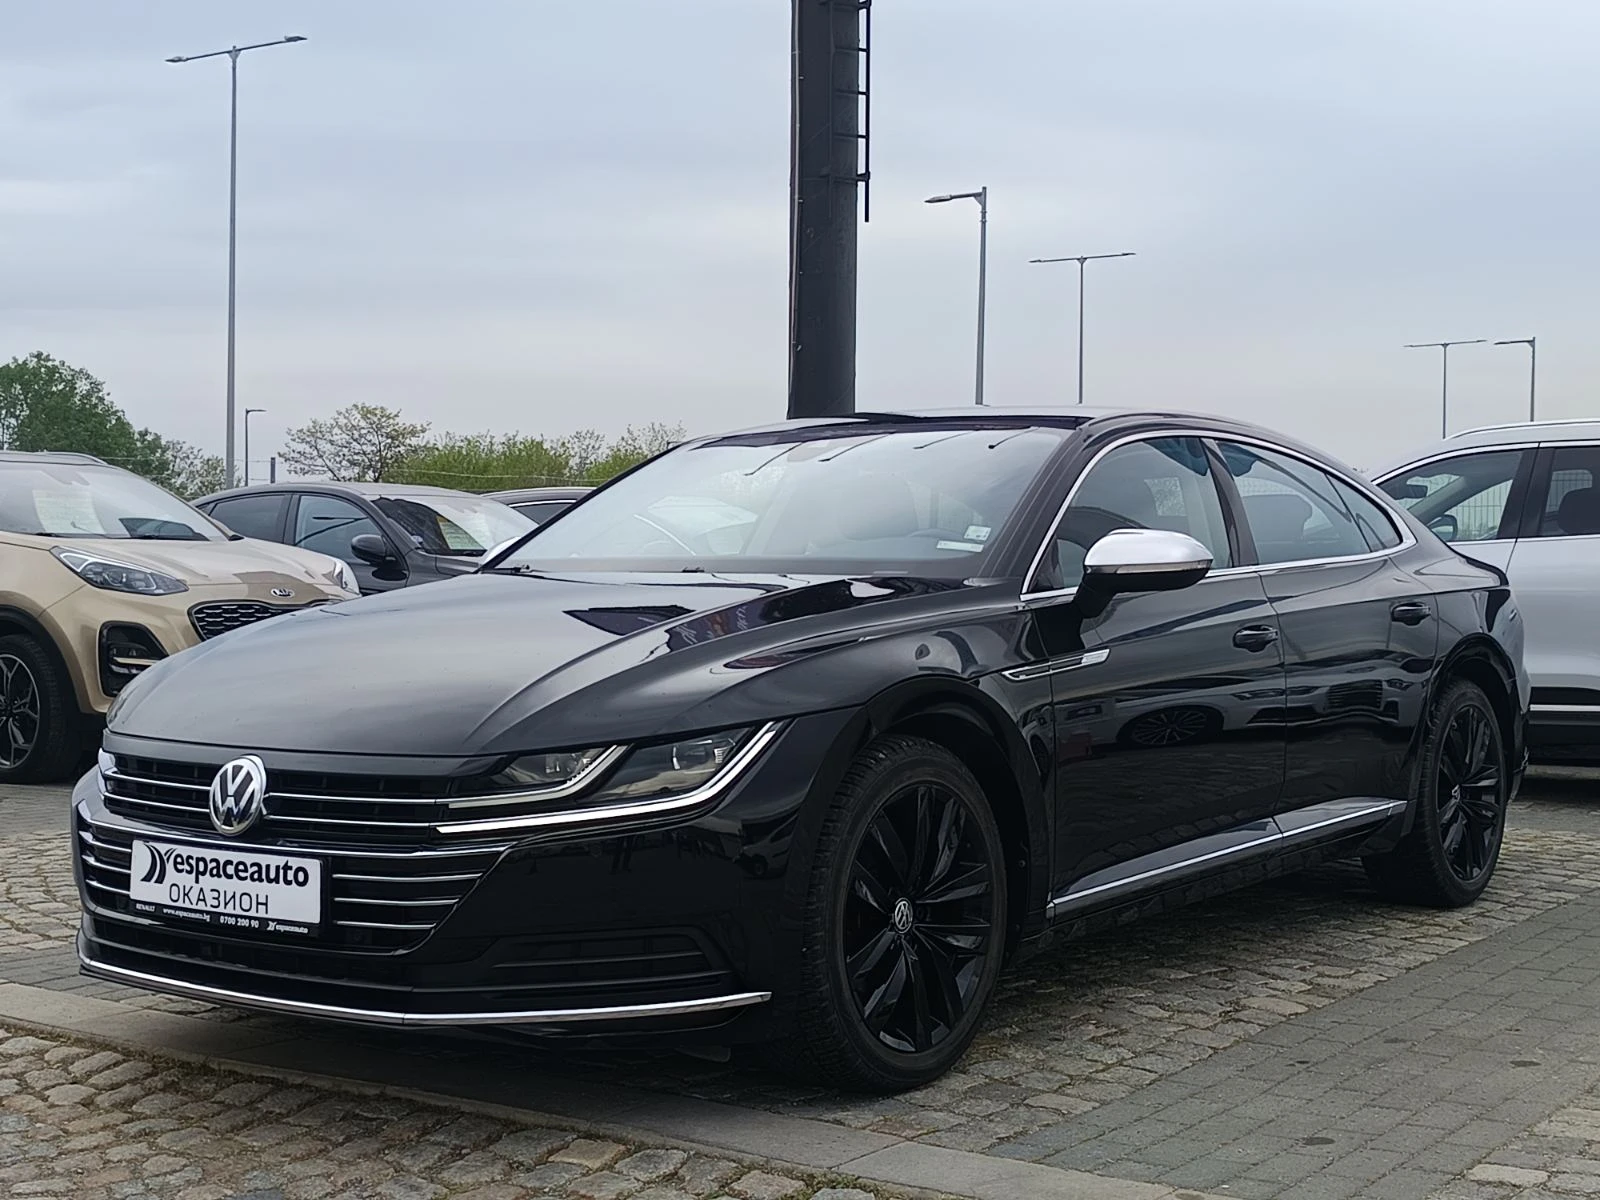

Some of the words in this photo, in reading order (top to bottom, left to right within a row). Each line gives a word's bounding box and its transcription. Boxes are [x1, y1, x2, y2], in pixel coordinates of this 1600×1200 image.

[173, 853, 309, 888] espaceauto
[169, 883, 269, 915] ОКАЗИОН
[220, 915, 236, 925] 0700
[250, 920, 259, 929] 90
